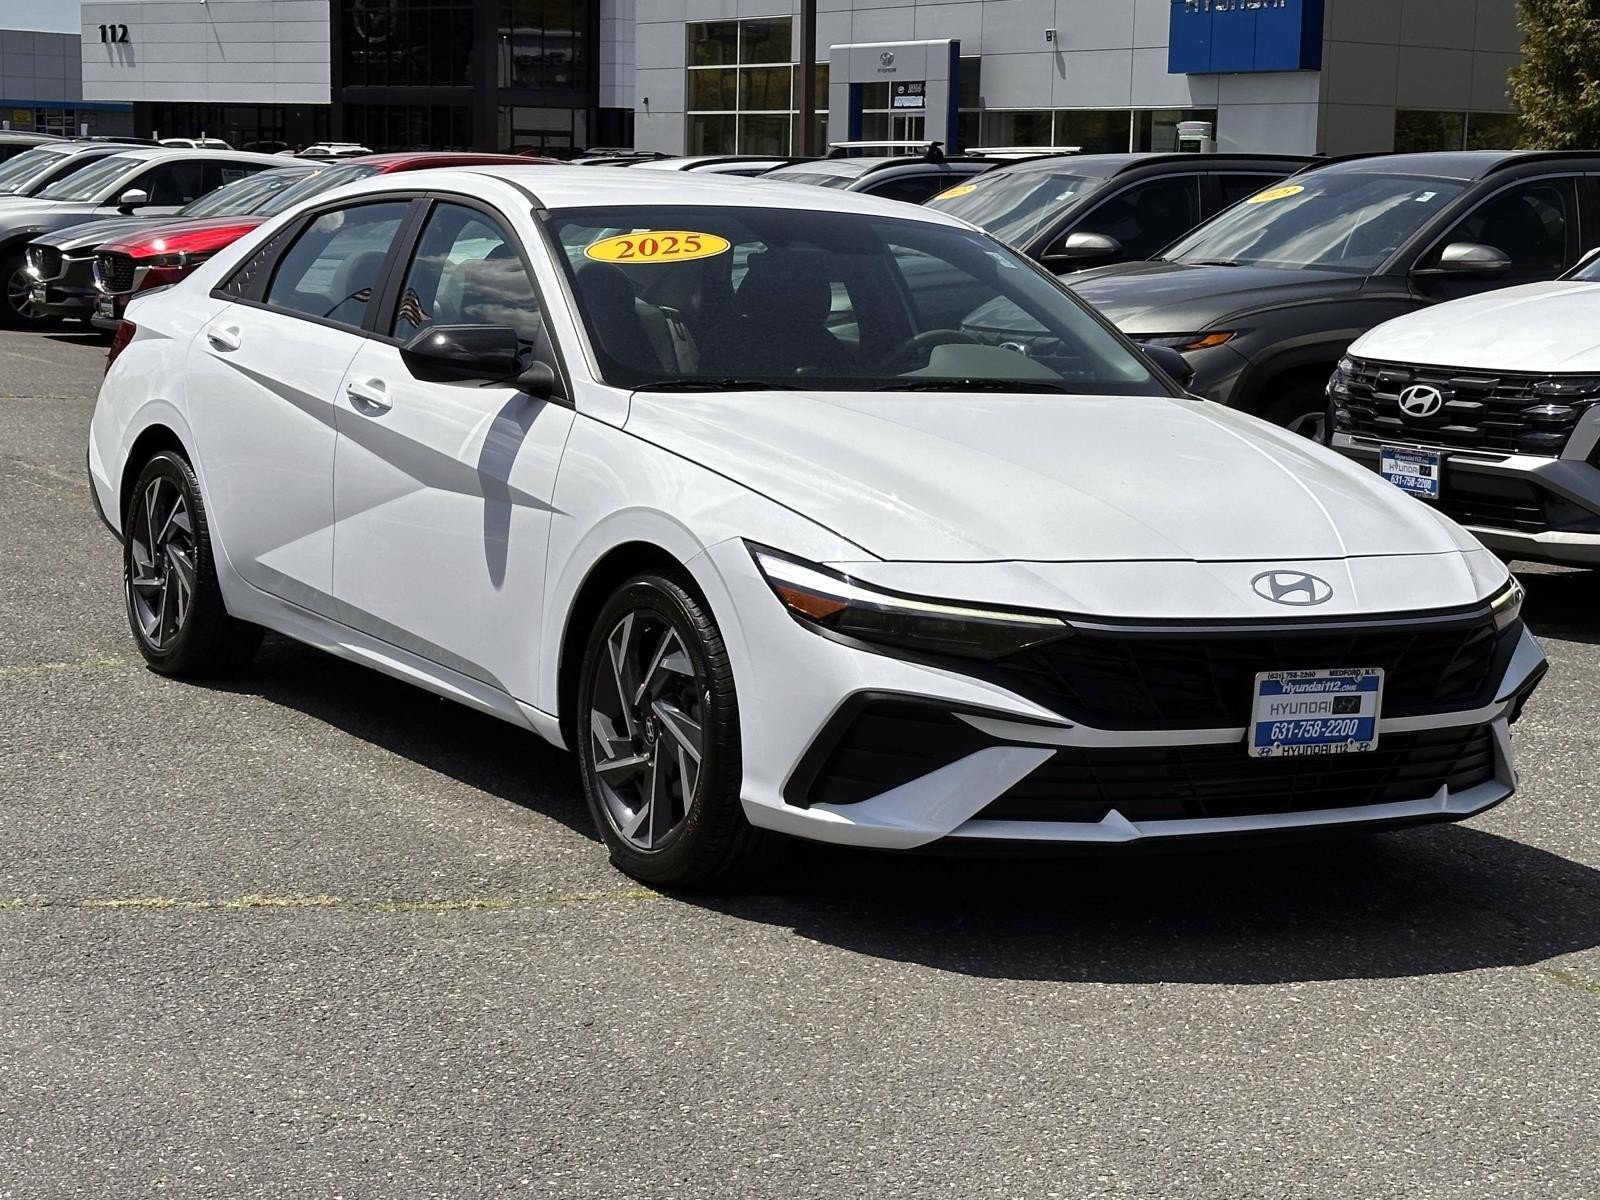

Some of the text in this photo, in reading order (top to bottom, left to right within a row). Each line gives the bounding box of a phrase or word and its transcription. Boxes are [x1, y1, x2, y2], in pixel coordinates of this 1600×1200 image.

[98, 24, 129, 43] 112
[615, 235, 702, 259] 2025
[1390, 474, 1432, 489] 631-758-2200
[1286, 671, 1316, 679] 758-2200
[1281, 681, 1358, 694] Hyundai112.com
[1270, 701, 1332, 716] HYUNDAI
[1270, 719, 1359, 740] 631-758-2200
[1281, 743, 1349, 757] HYUNDAI 112
